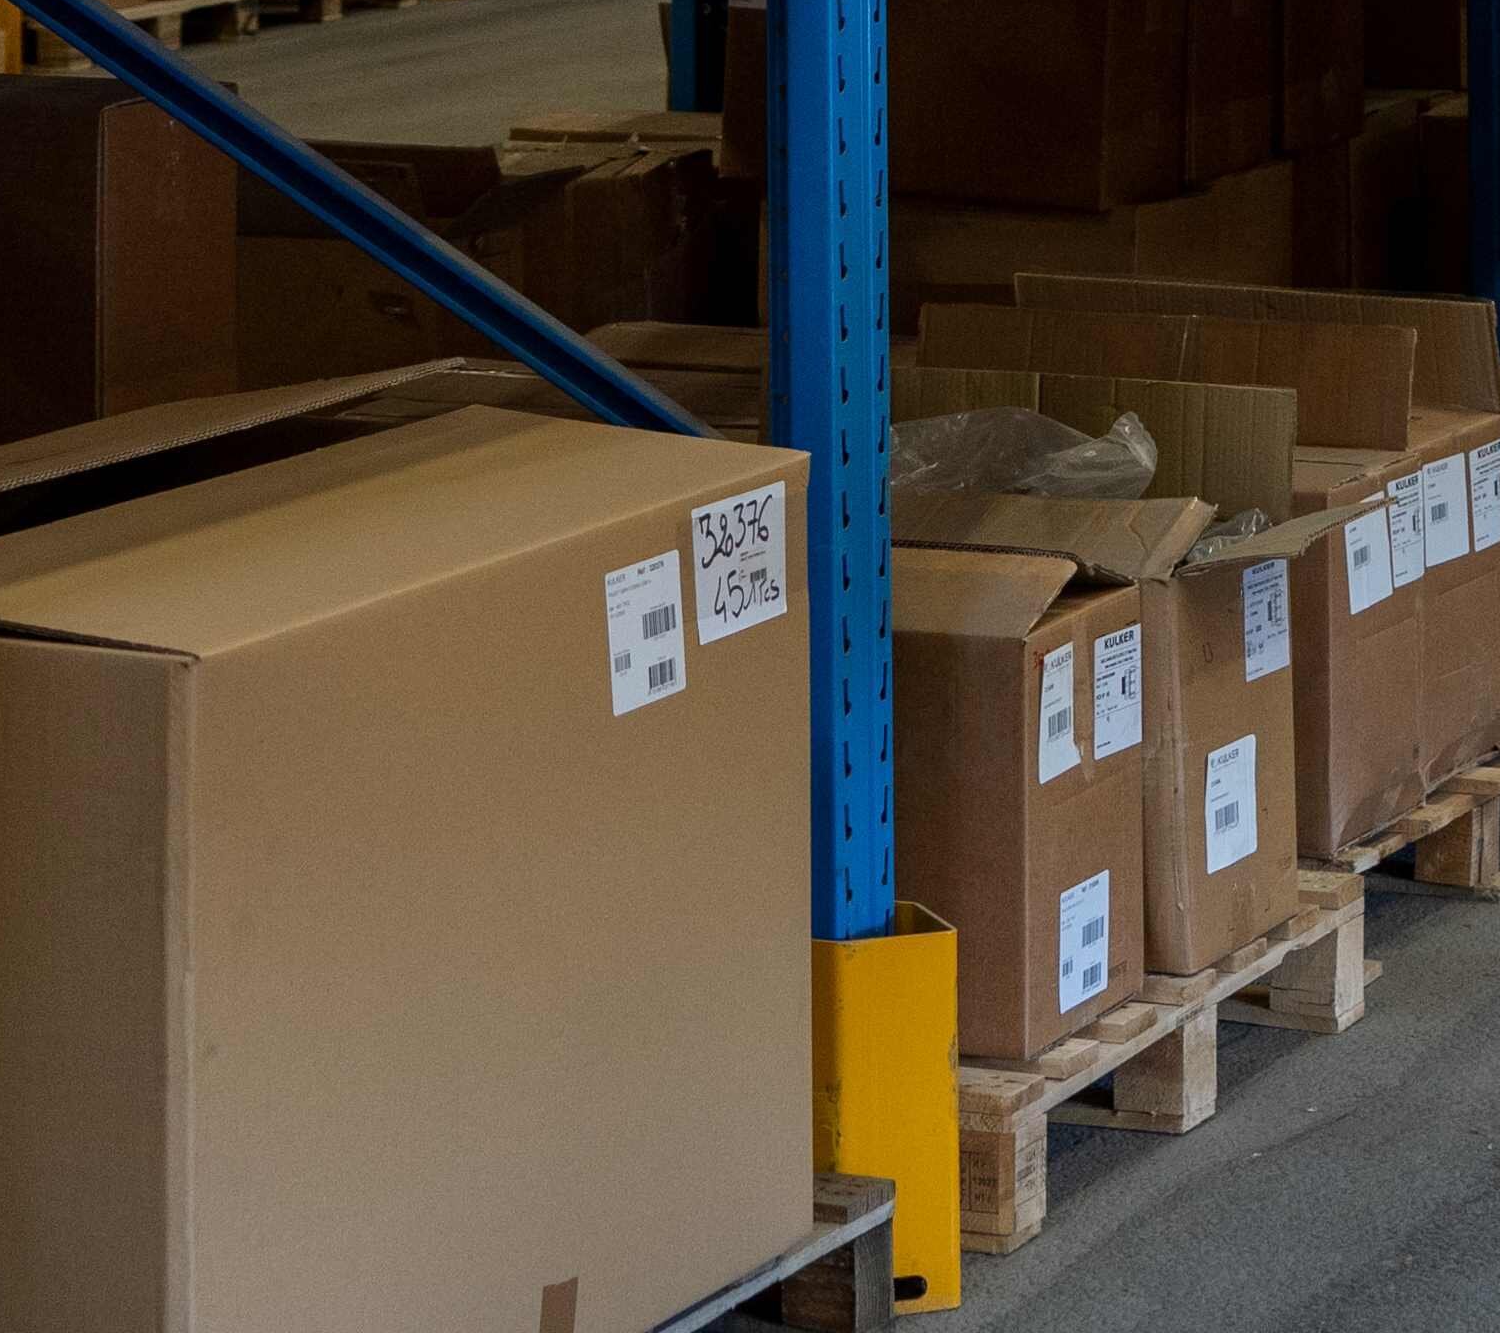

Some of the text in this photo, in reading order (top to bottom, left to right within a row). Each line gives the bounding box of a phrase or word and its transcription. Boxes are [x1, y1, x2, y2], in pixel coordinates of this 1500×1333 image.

[1396, 476, 1419, 492] KULKER
[1252, 562, 1275, 575] KULKER
[1104, 630, 1134, 649] KULKER
